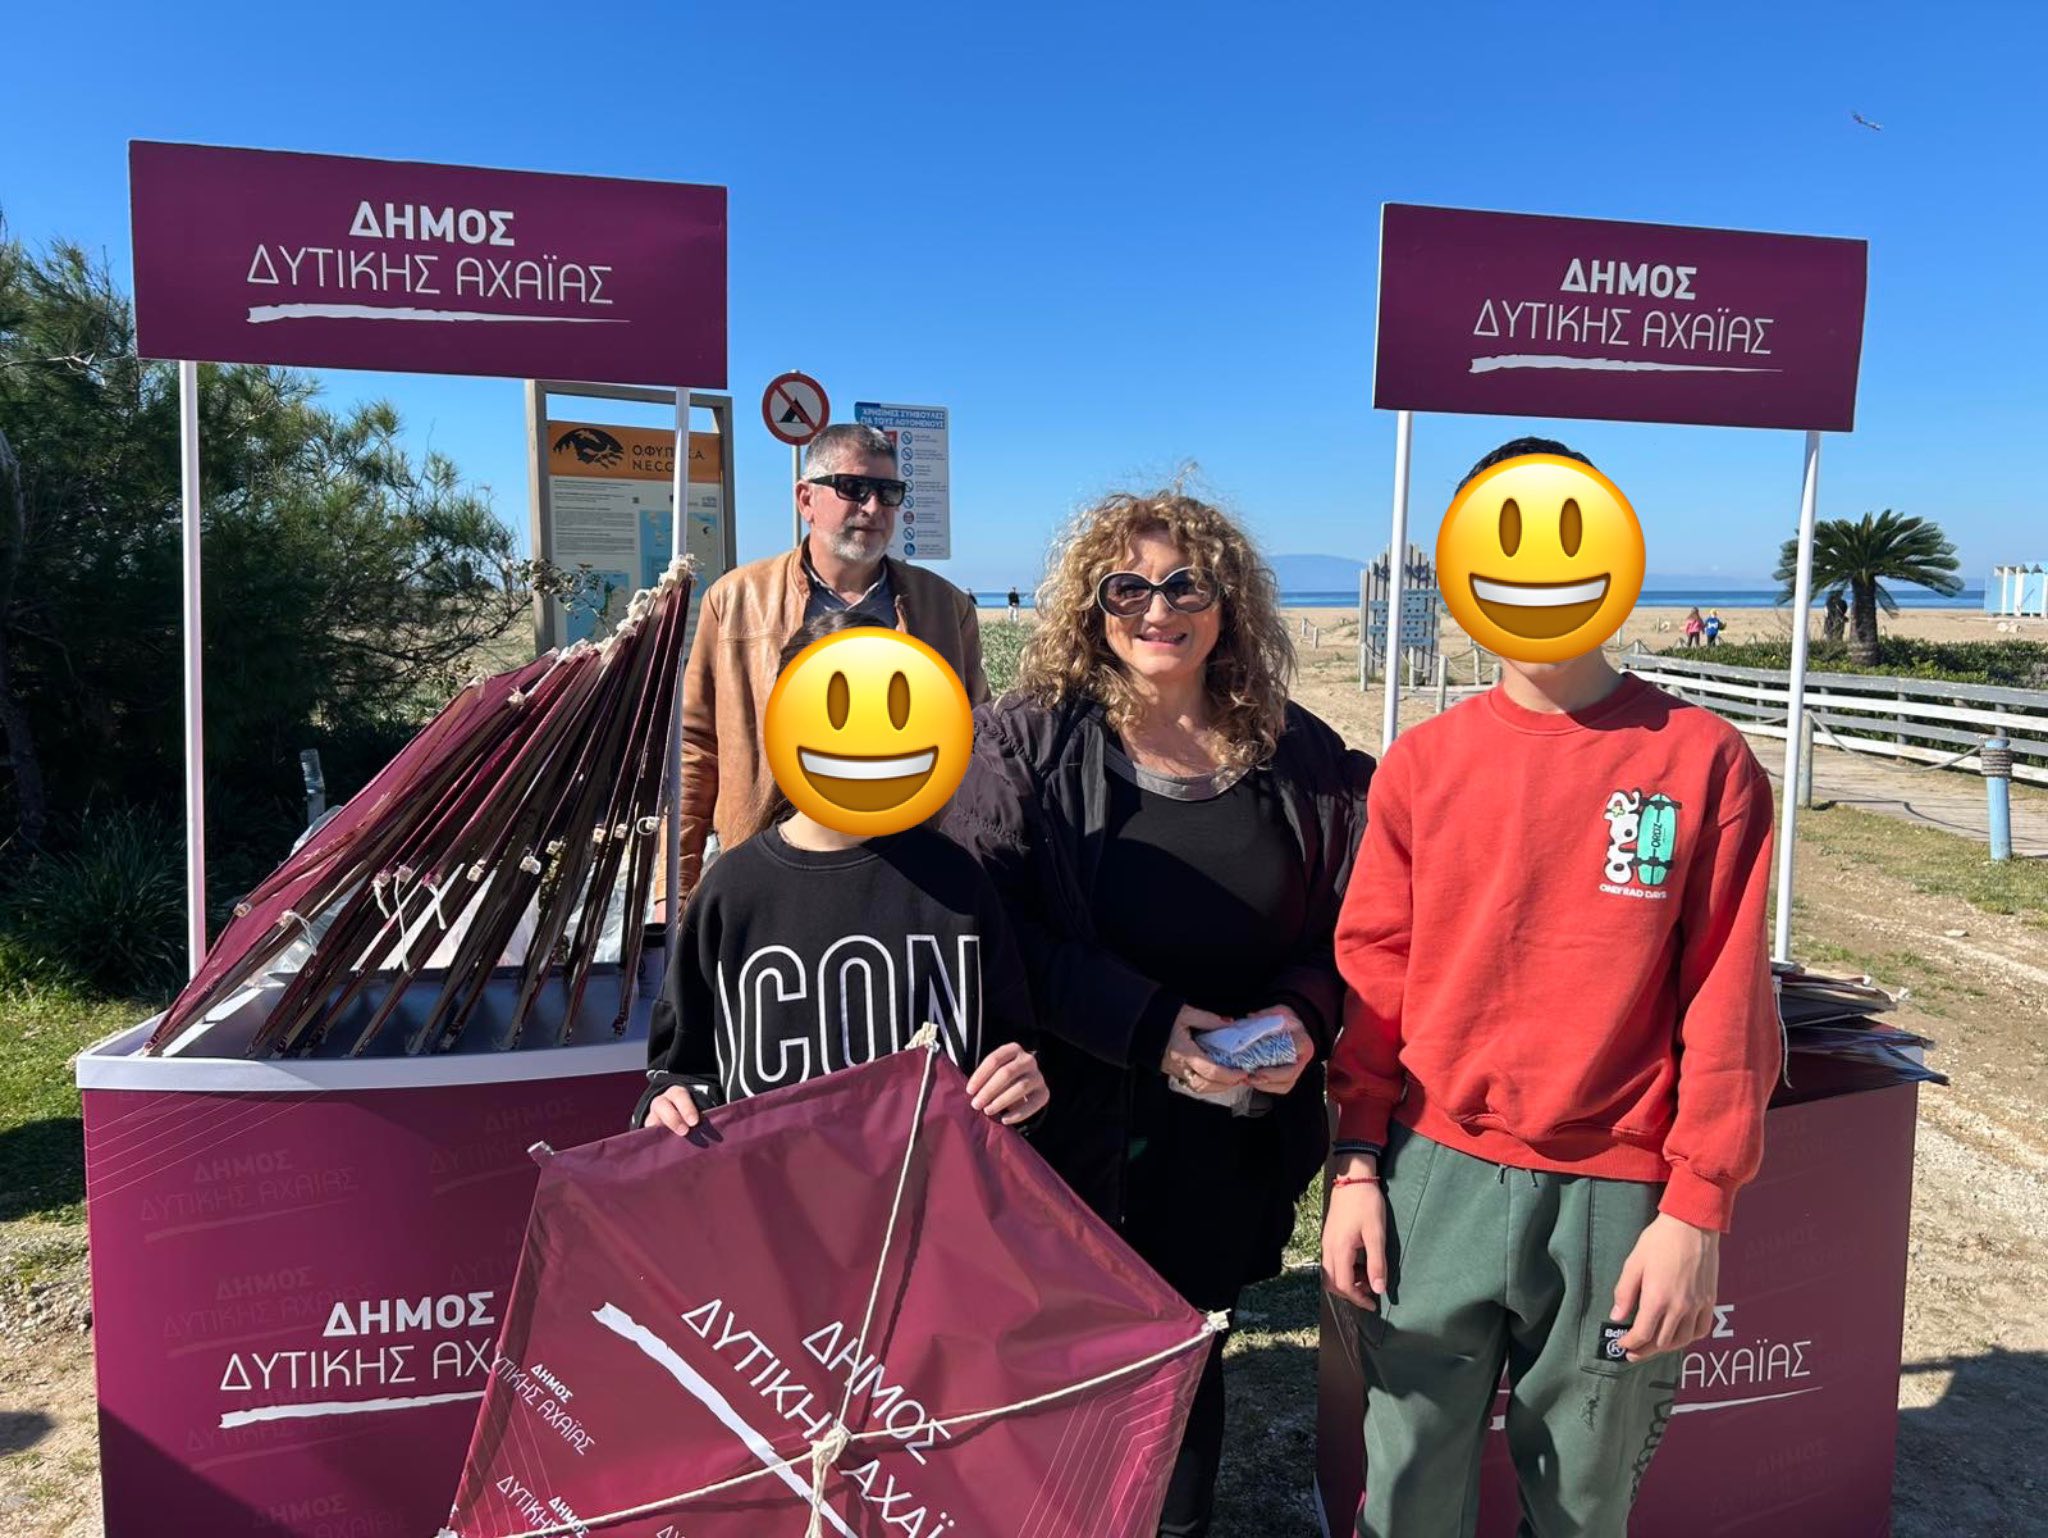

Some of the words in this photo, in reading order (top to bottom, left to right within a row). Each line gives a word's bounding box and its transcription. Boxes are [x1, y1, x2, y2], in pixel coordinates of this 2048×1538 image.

[349, 200, 515, 246] ΔΗΜΟΣ
[246, 243, 441, 294] ΔΥΤΙΚΗΣ
[456, 253, 613, 304] ΑΧΑΪΑΣ
[1560, 258, 1697, 300] ΔΗΜΟΣ
[1473, 298, 1632, 346] ΔΥΤΙΚΗΣ
[1643, 307, 1774, 355] ΑΧΑΪΑΣ
[323, 1290, 495, 1337] ΔΗΜΟΣ
[220, 1345, 415, 1392] ΔΥΤΙΚΗΣ
[530, 1363, 573, 1404] ΔΗΜΟΣ
[1680, 1337, 1813, 1390] ΑΧΑΪΑΣ
[492, 1351, 545, 1406] ΥΤΙΚΗΣ
[537, 1399, 595, 1456] ΑΧΑΪΑΣ
[681, 1299, 832, 1440] ΔΥΤΙΚΗ
[840, 1459, 955, 1538] ΑΧΑΪ
[802, 1321, 951, 1465] ΔΗΜΟΣ
